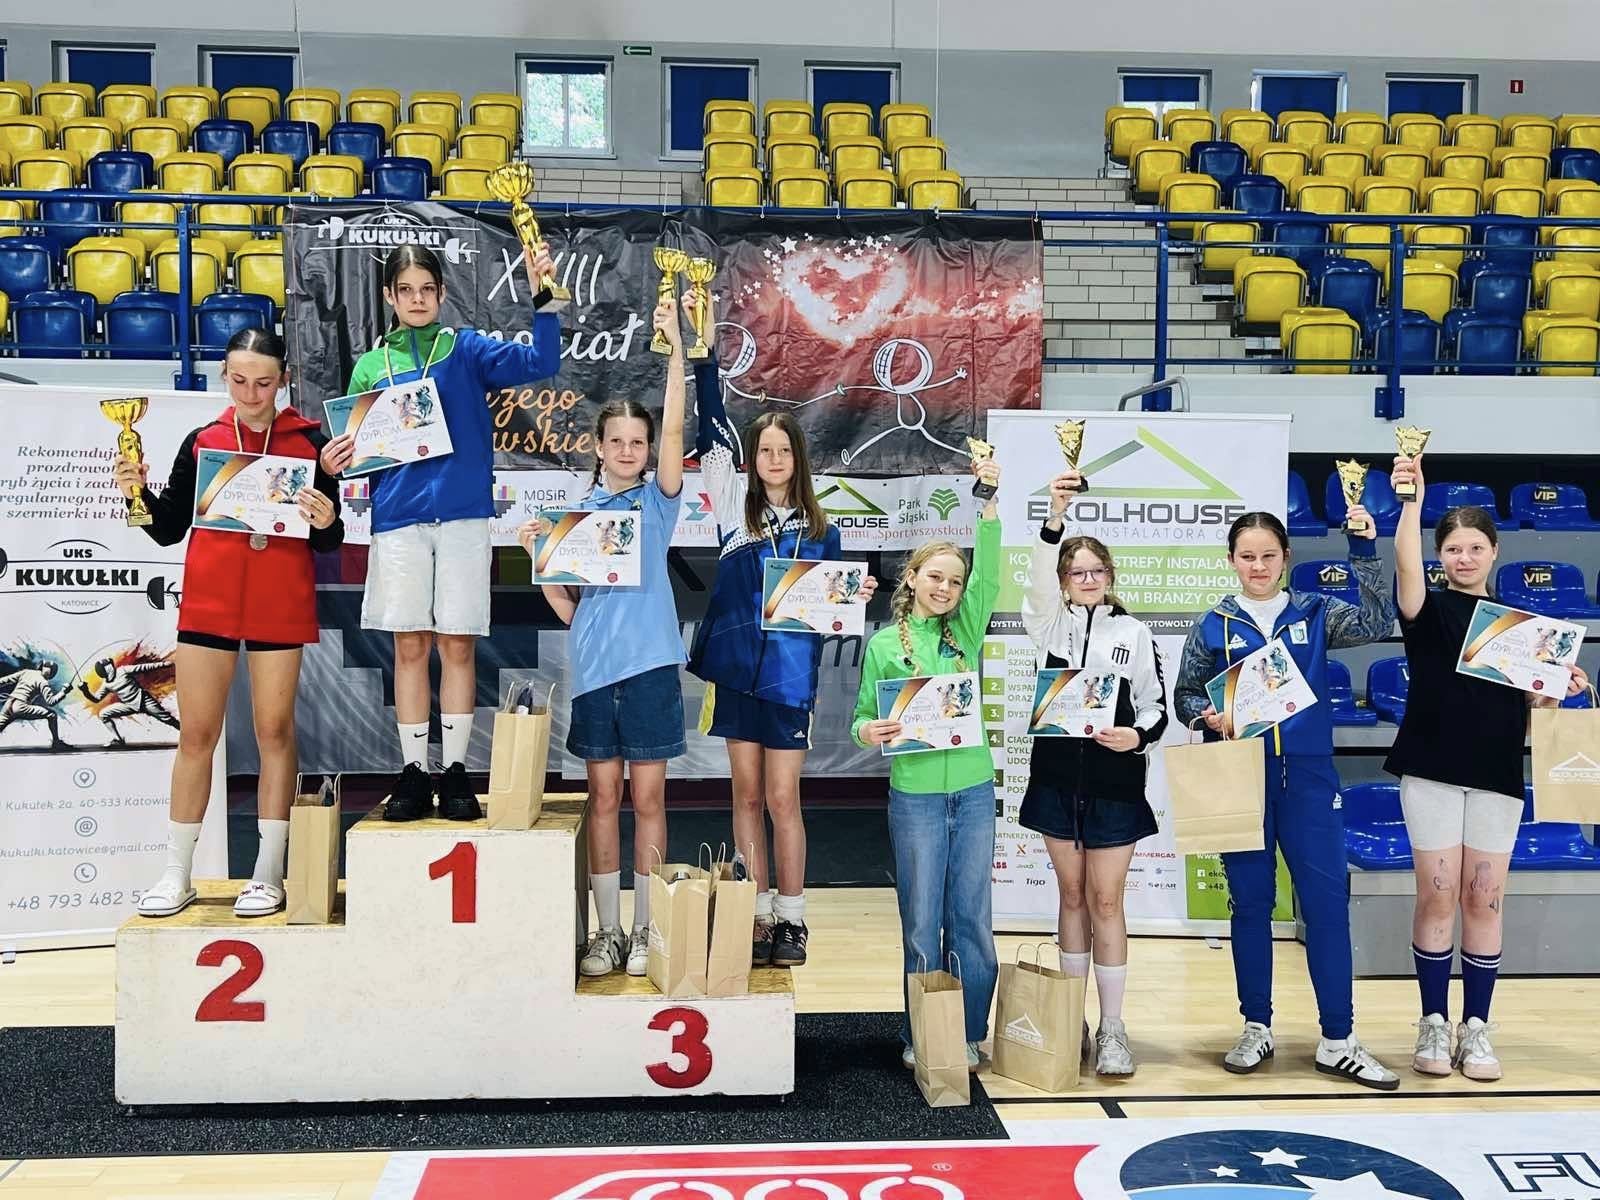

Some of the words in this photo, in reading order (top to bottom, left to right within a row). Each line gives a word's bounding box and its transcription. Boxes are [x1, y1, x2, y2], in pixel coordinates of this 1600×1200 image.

[348, 229, 440, 245] KUKUŁKI
[488, 248, 603, 306] XIII
[31, 476, 71, 490] życia
[76, 478, 80, 488] i
[1534, 491, 1557, 501] VIP
[898, 498, 921, 510] Park
[6, 507, 88, 519] szermierki
[911, 525, 972, 538] wszystkich
[1095, 527, 1205, 539] INSTALATORA
[63, 548, 93, 558] UKS
[1167, 556, 1229, 571] INSTALAT
[15, 569, 139, 586] KUKUŁKI
[1166, 575, 1240, 589] EKOLHOU
[1320, 572, 1348, 582] VIP
[1524, 573, 1552, 583] VIP
[1144, 590, 1201, 606] BRANŻY
[991, 620, 1024, 628] DYSTRY
[991, 682, 1001, 691] 2.
[1008, 694, 1033, 702] ORAZ
[991, 709, 1000, 718] 3.
[990, 734, 1001, 744] 4.
[1135, 851, 1176, 859] MMERGAS
[428, 841, 477, 923] 1
[1025, 878, 1046, 886] Tigo
[8, 896, 40, 910] +48
[49, 895, 83, 908] 793
[90, 892, 124, 905] 482
[195, 939, 266, 1022] 2
[645, 1007, 713, 1089] 3
